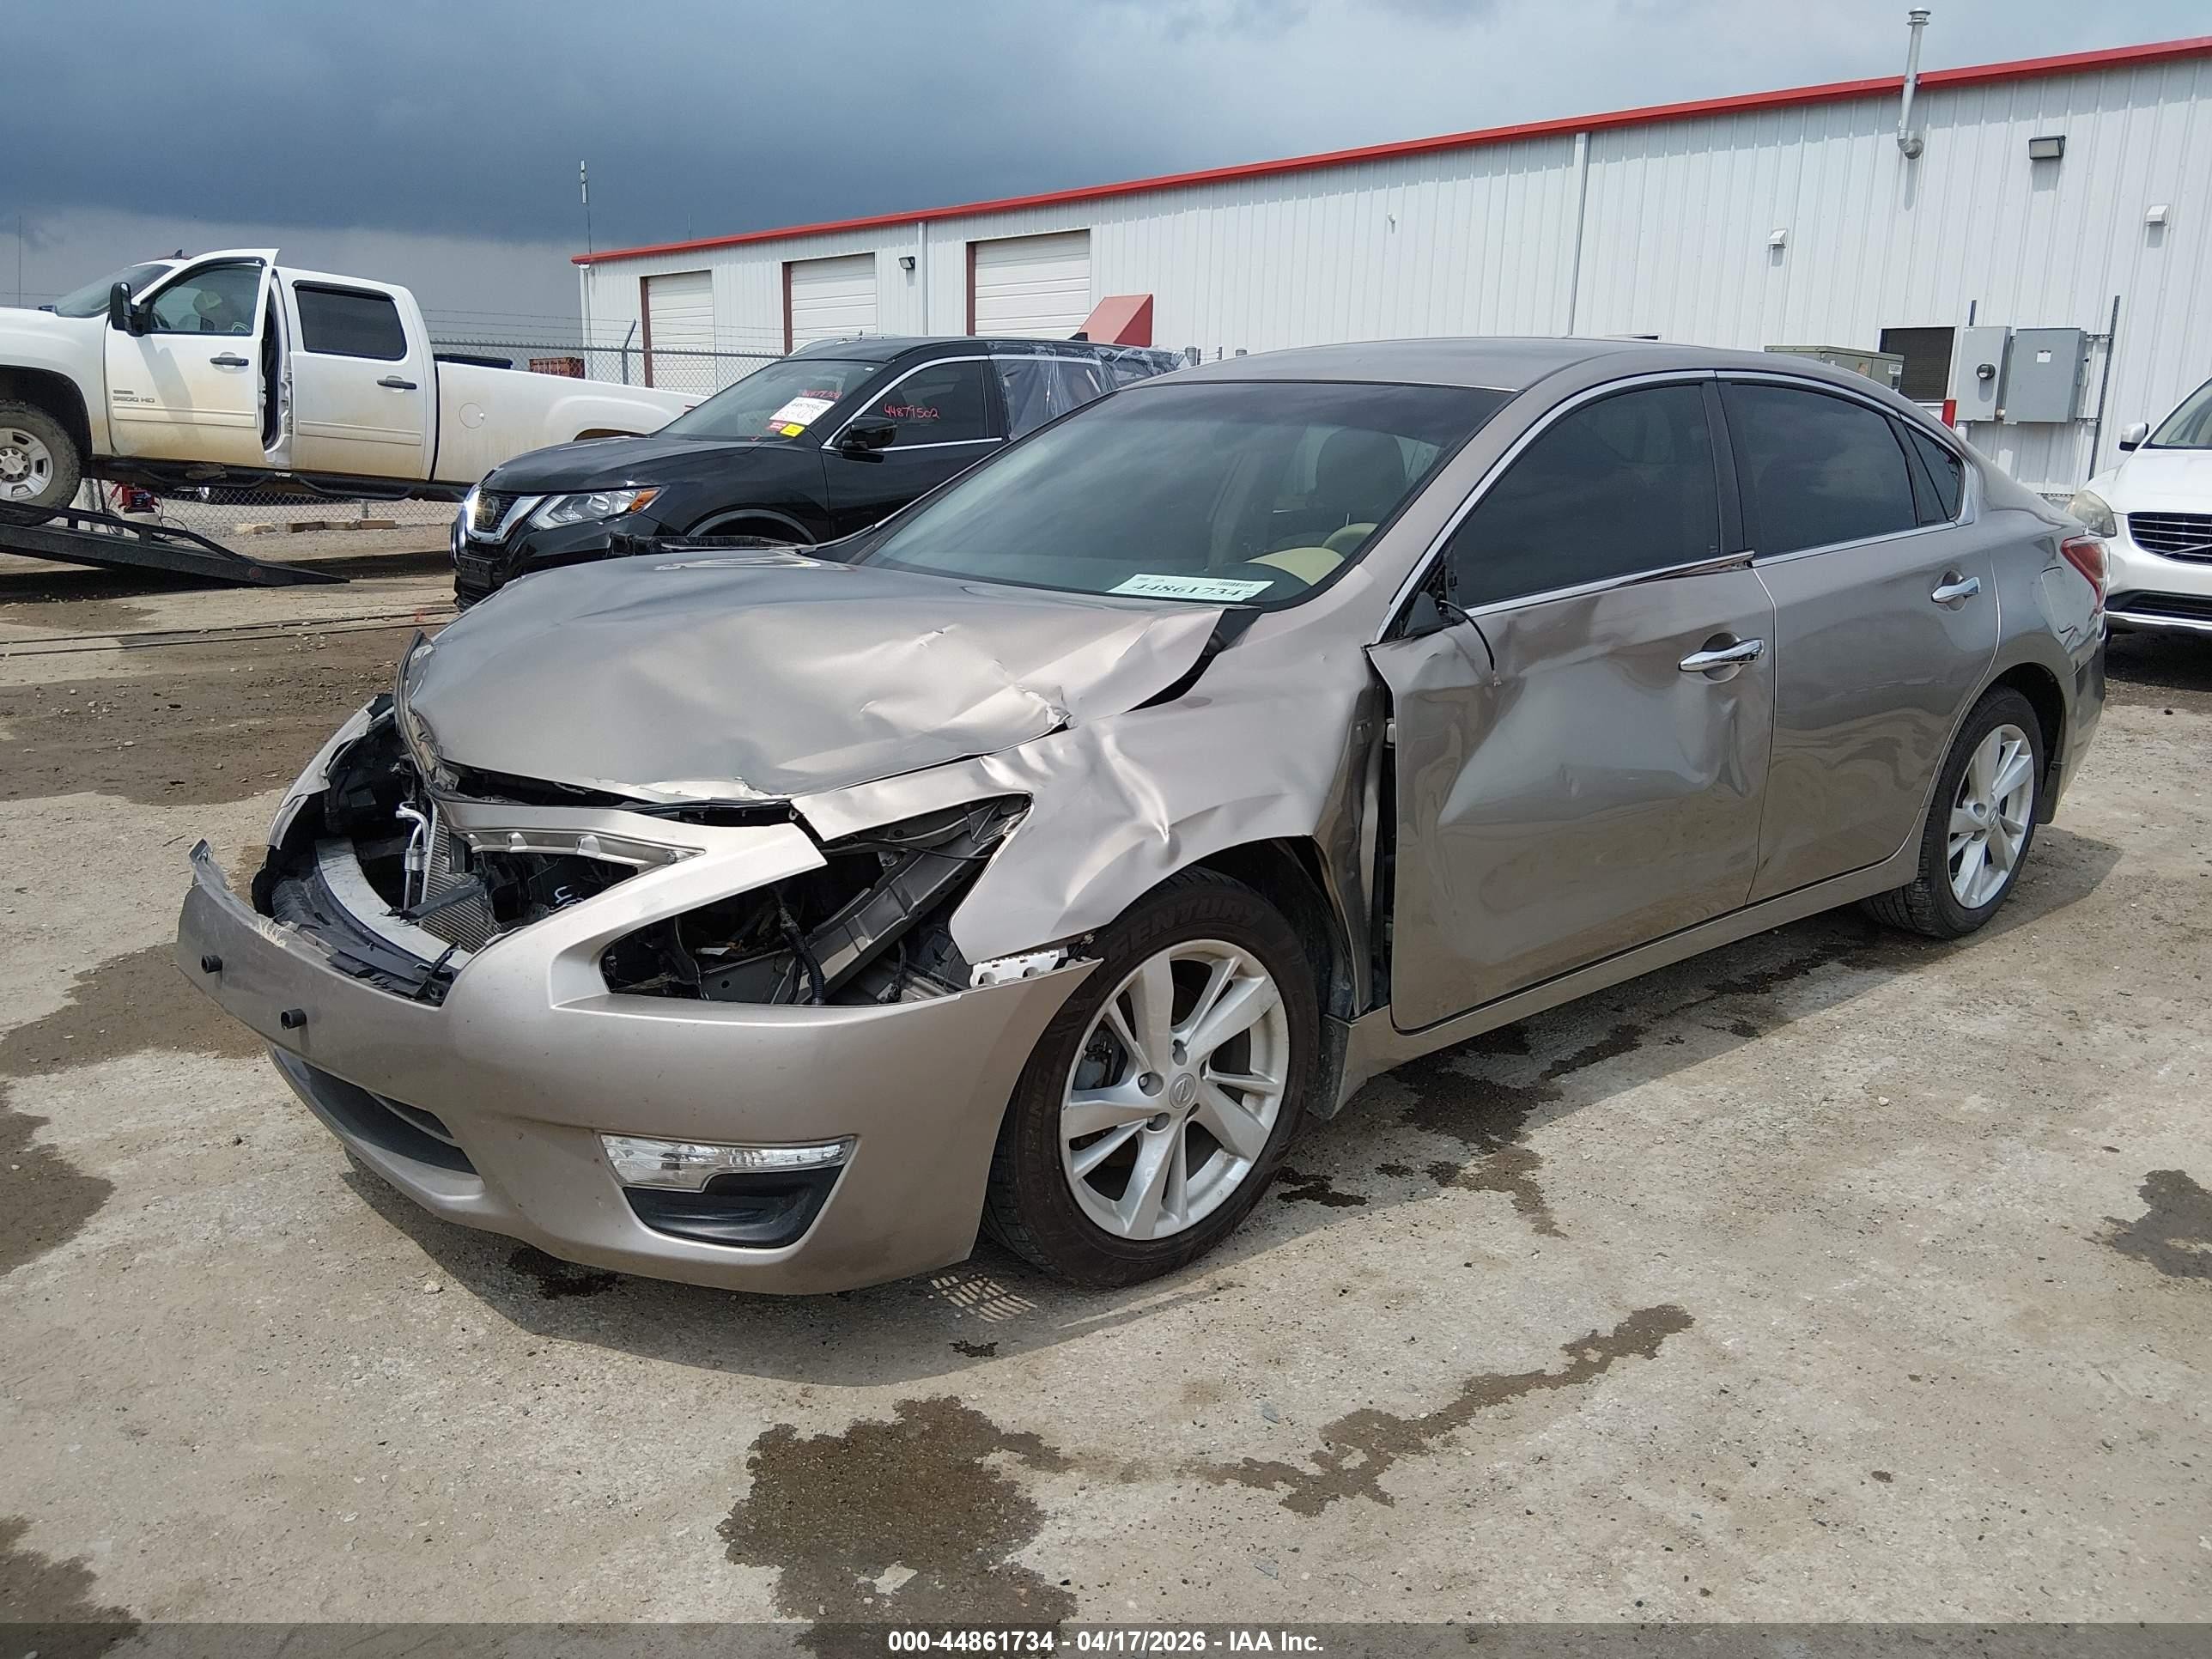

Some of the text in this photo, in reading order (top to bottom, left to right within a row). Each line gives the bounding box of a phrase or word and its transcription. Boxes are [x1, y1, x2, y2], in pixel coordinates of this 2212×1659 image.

[884, 404, 940, 419] 44879502
[1133, 584, 1241, 596] 44861734
[1108, 897, 1264, 965] SENTURY
